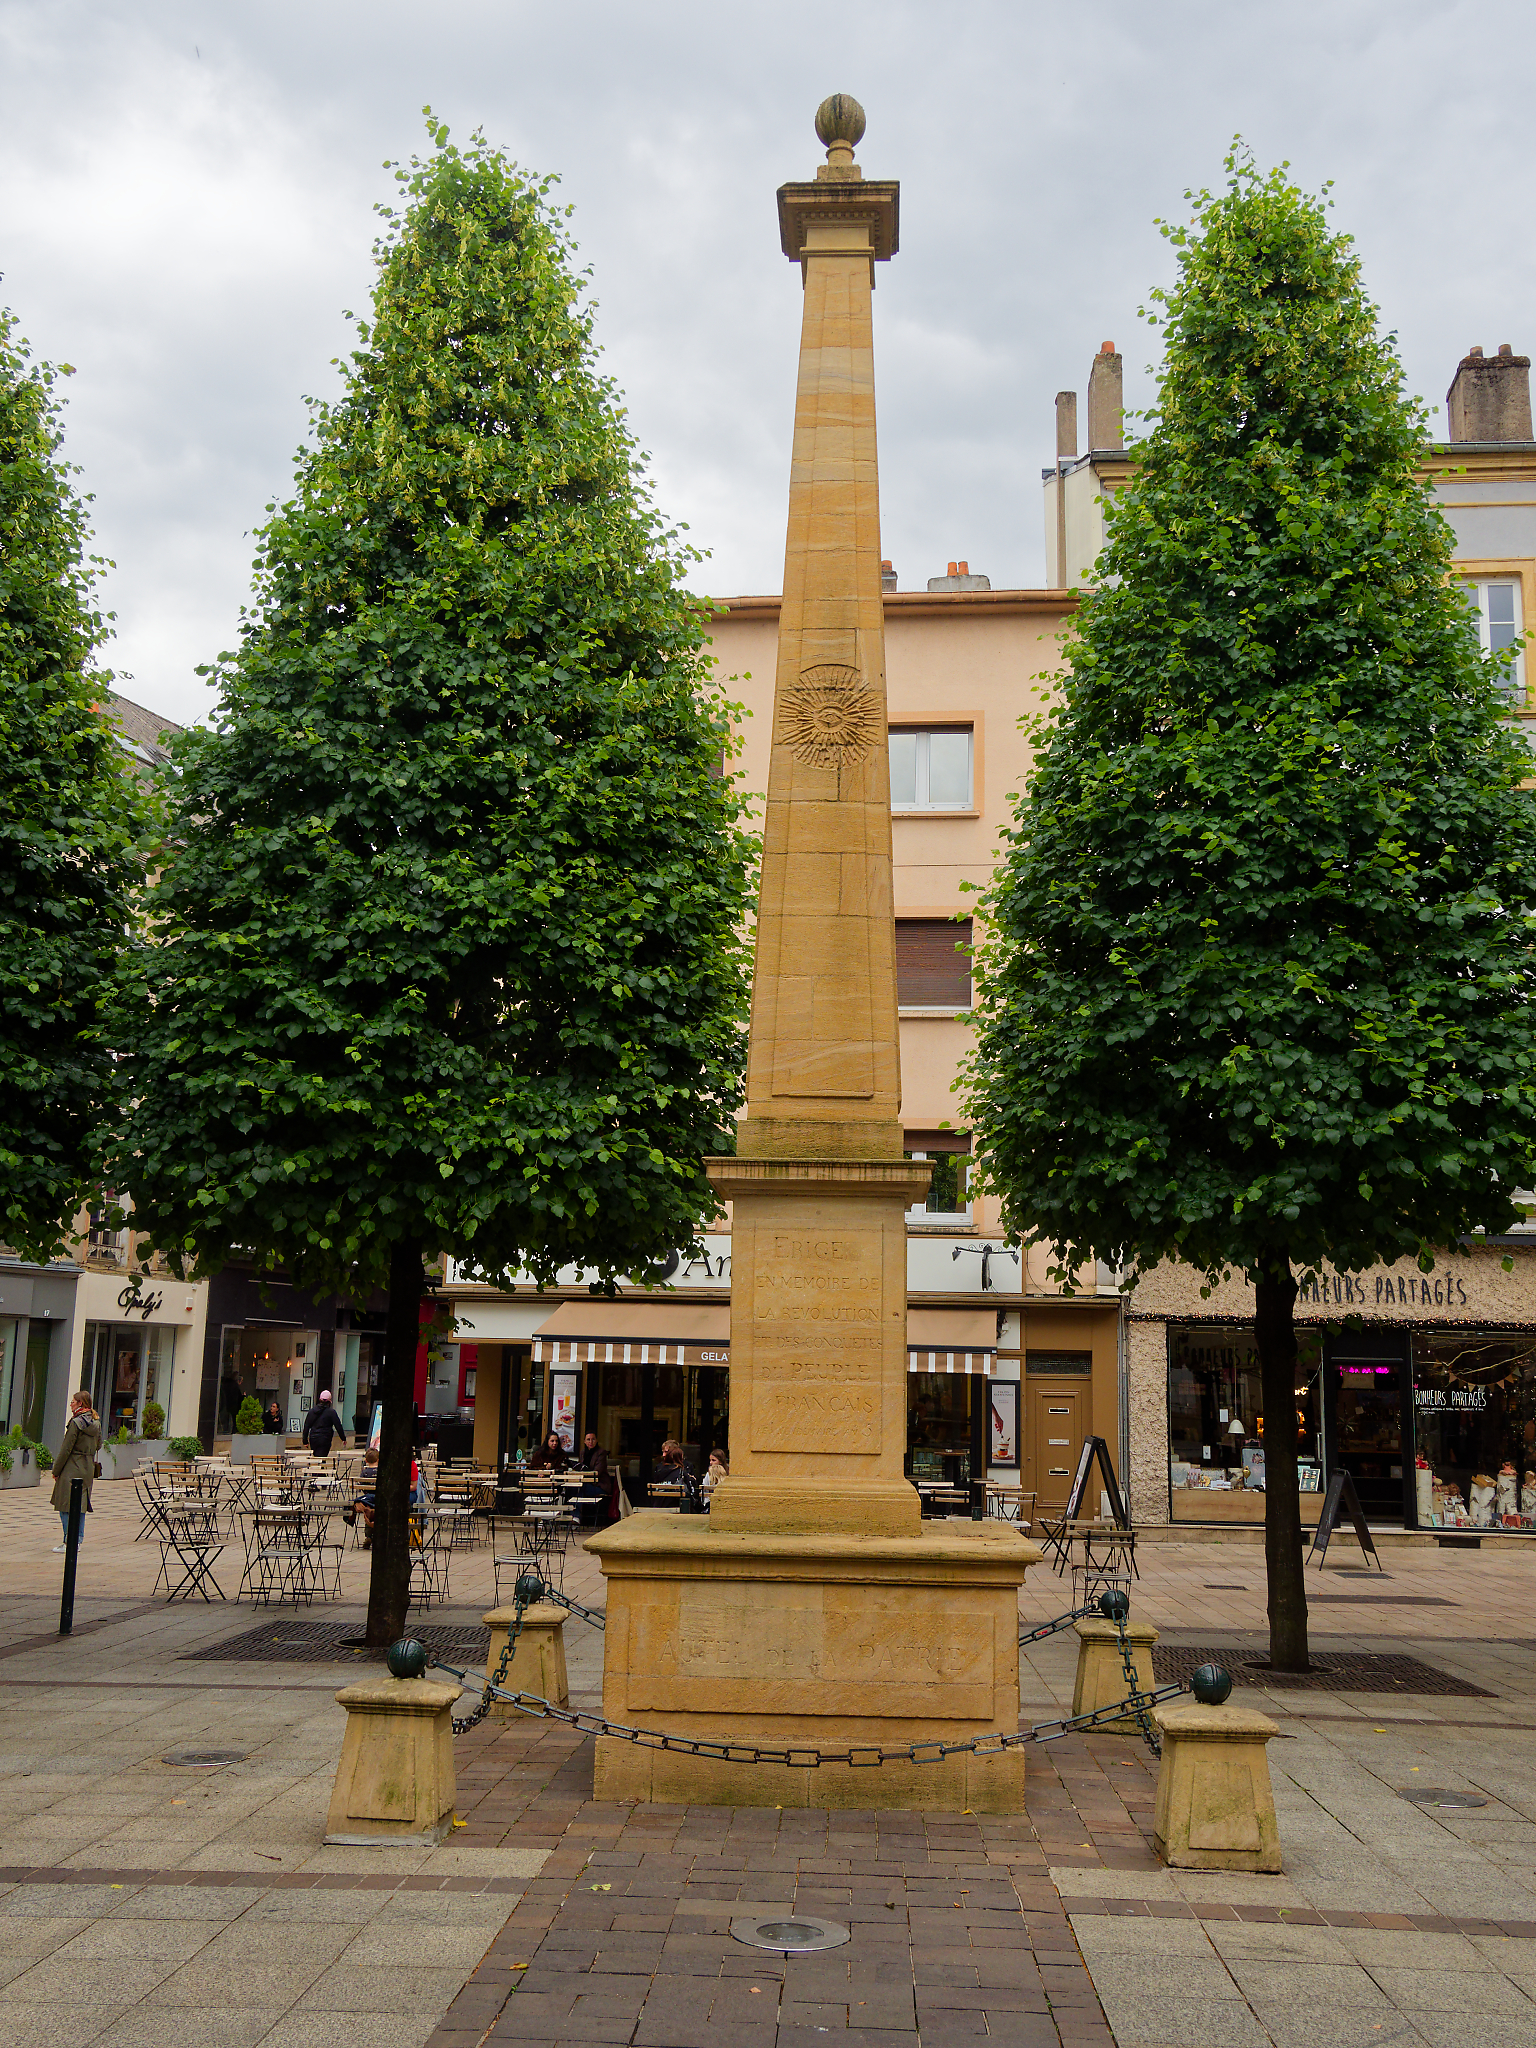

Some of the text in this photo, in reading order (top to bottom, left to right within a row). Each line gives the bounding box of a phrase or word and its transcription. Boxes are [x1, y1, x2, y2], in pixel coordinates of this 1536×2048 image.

[859, 1277, 880, 1290] DE
[1375, 1271, 1467, 1305] PARTAGÉS
[757, 1307, 775, 1320] LA
[777, 1336, 800, 1349] DES
[701, 1351, 730, 1362] GELA
[789, 1362, 870, 1381] PEUPLE
[657, 1639, 748, 1665] AUTEL
[767, 1649, 794, 1667] DE
[858, 1644, 962, 1672] PATRIE
